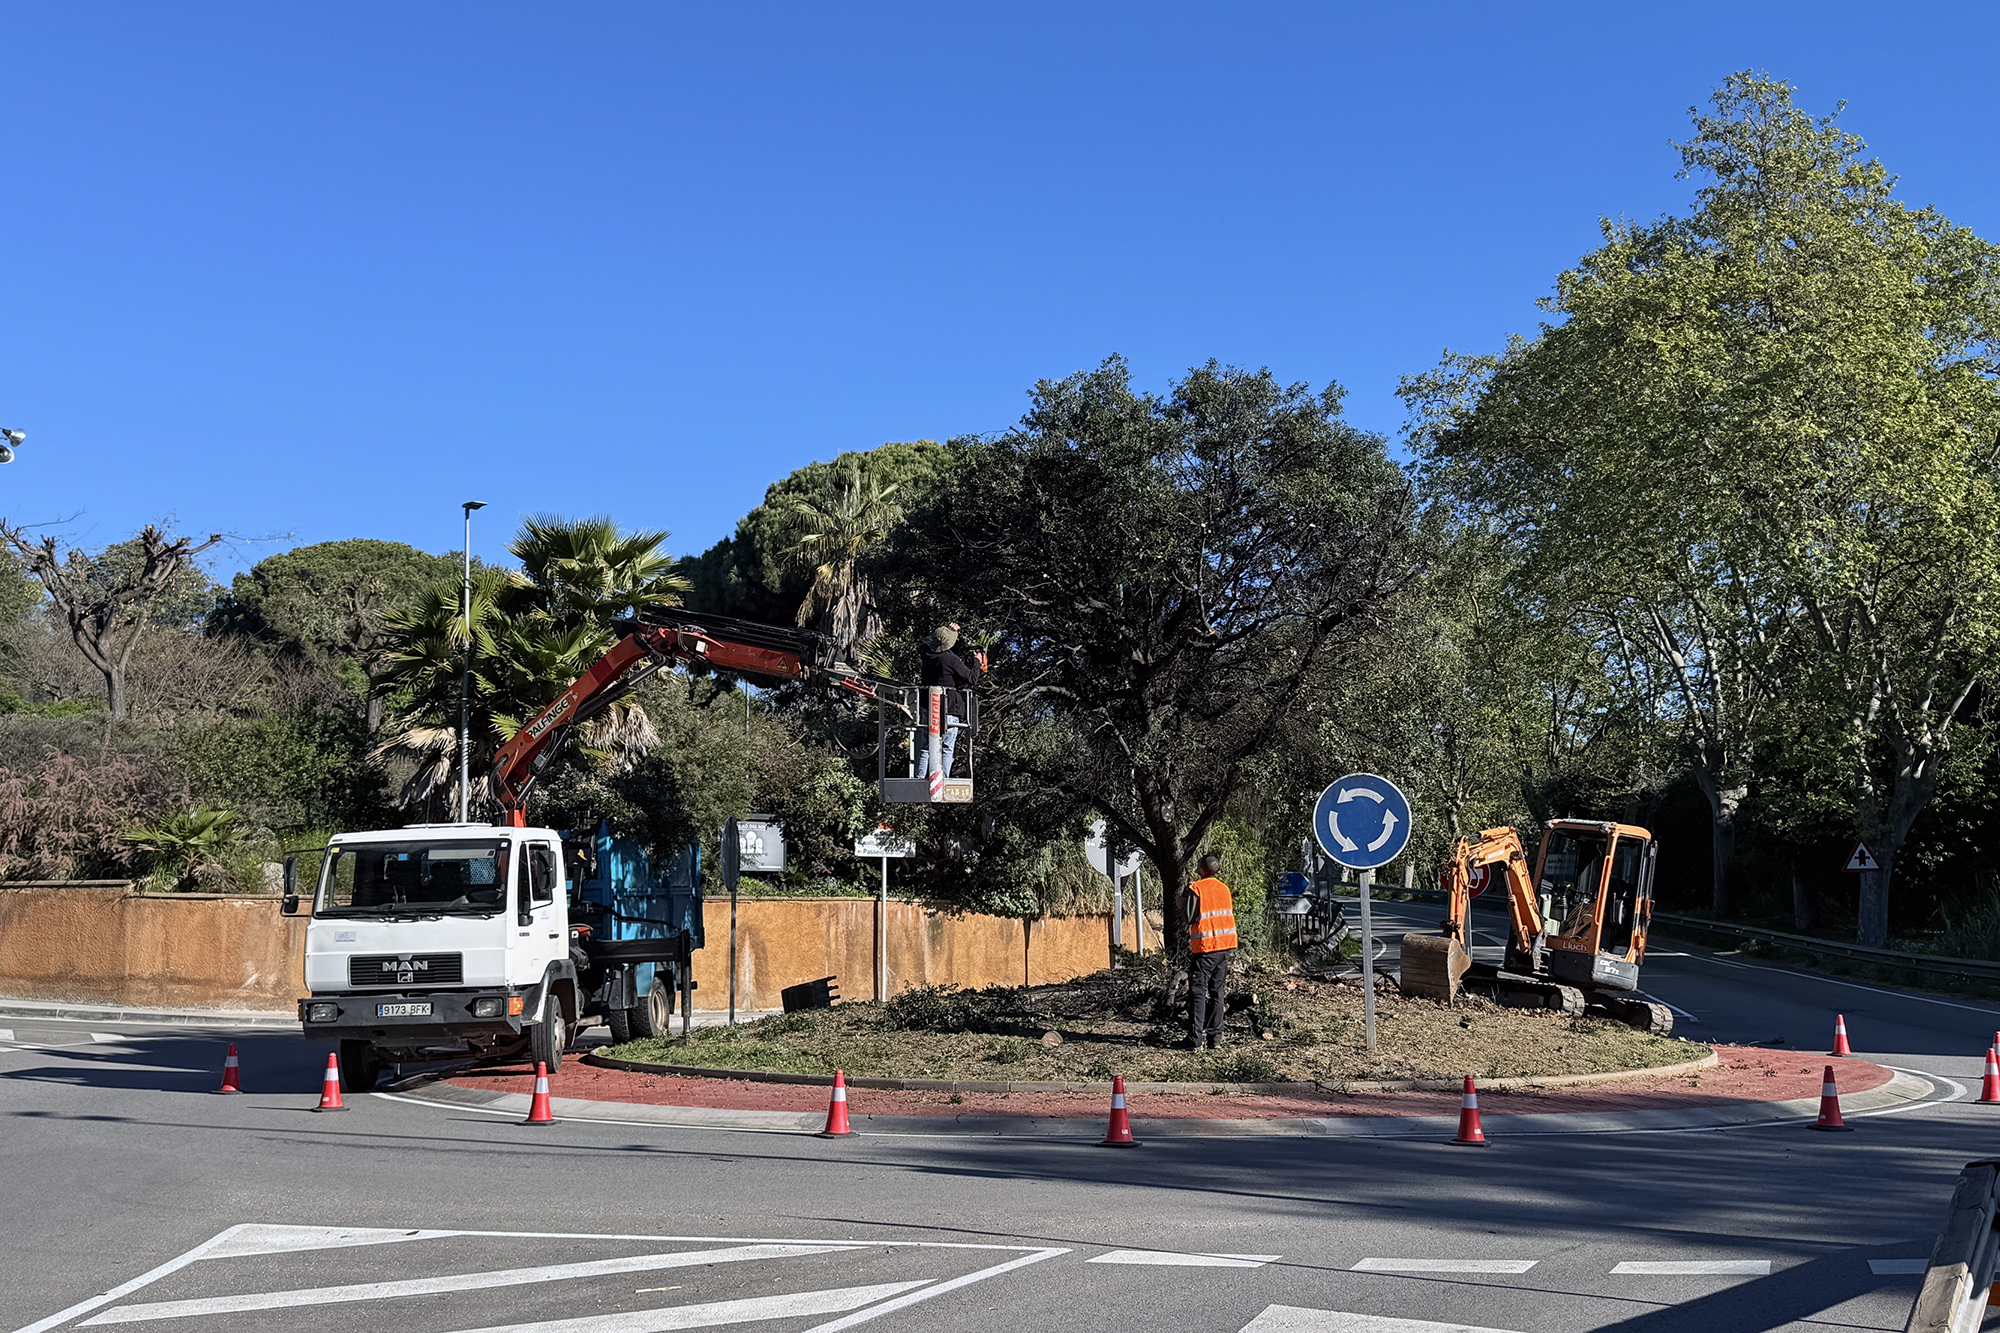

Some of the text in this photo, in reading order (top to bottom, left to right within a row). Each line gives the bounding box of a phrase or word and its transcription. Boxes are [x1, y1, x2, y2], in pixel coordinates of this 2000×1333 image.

[526, 698, 571, 738] PALFINGE
[929, 692, 940, 735] Ferrari
[1563, 941, 1587, 952] Lluch
[382, 960, 428, 972] MAN
[384, 1004, 427, 1015] 9173 BFK
